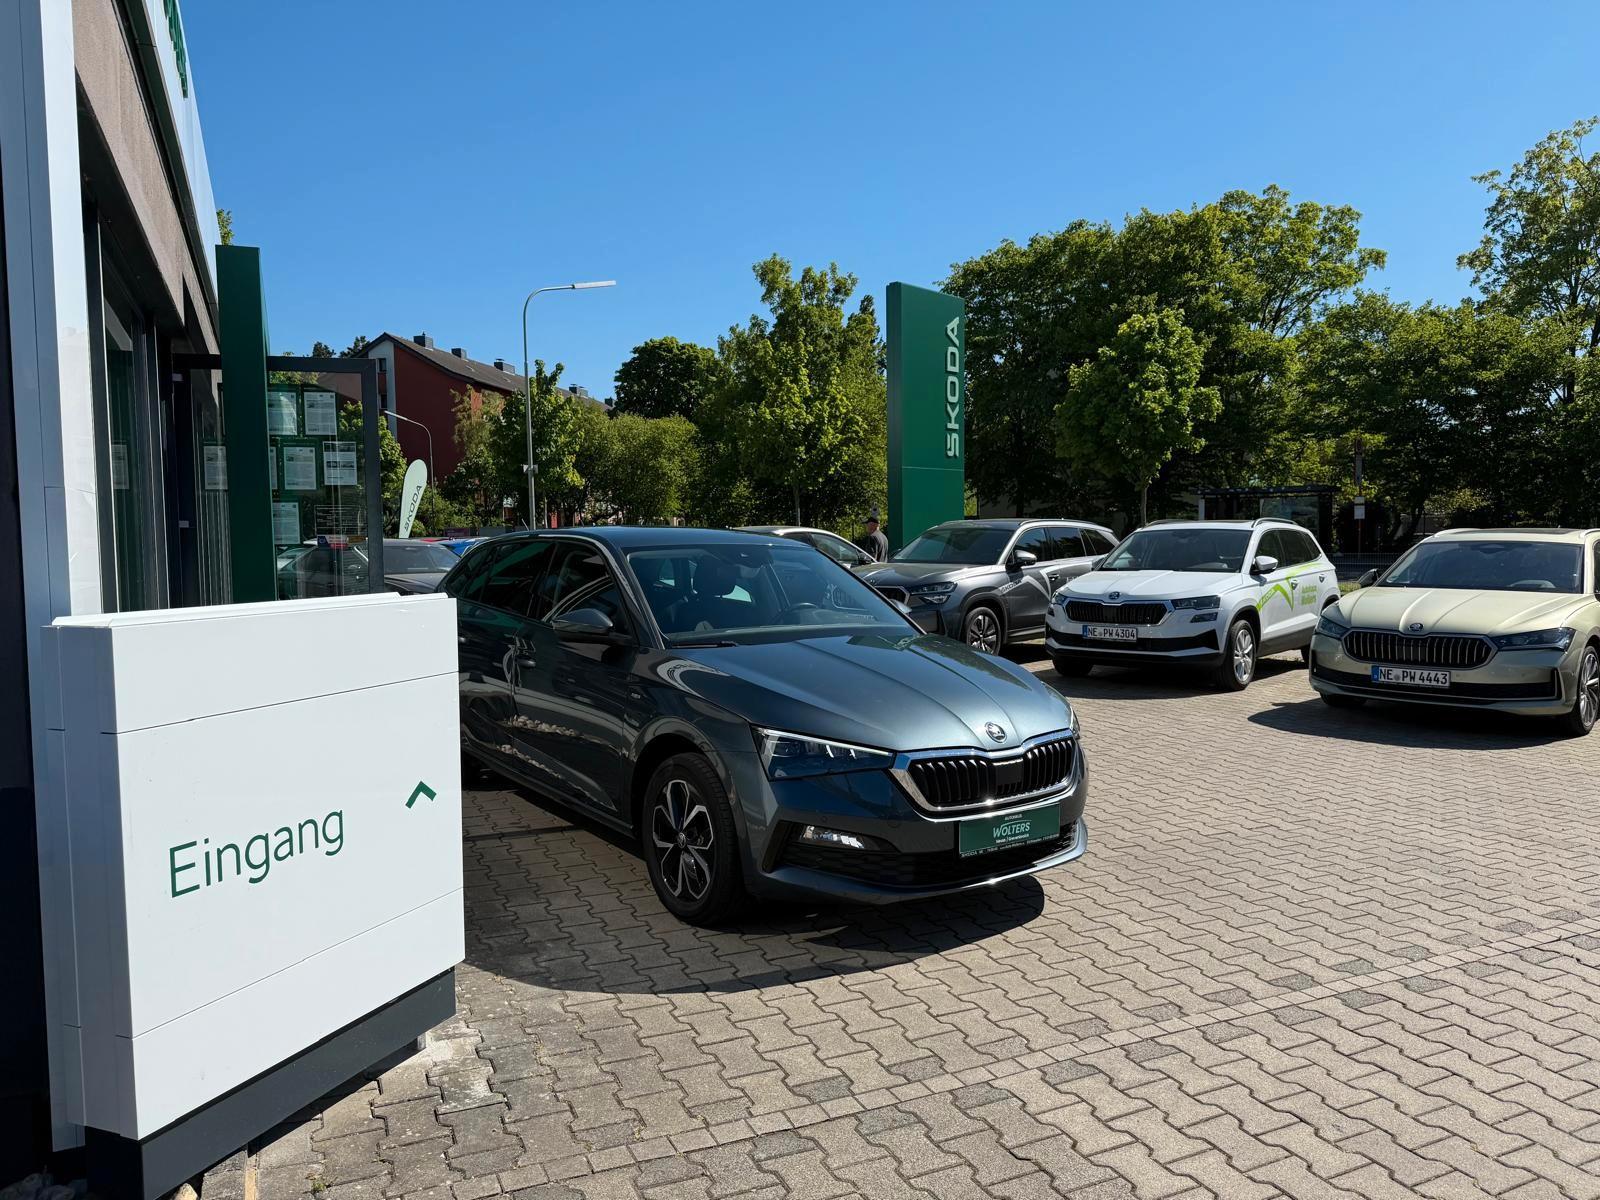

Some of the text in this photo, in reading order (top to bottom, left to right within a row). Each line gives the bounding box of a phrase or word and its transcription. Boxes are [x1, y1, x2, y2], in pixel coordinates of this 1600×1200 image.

[1088, 627, 1135, 639] NE PW 4304
[1379, 668, 1448, 685] NE PW 4443
[992, 821, 1031, 839] WOLTERS
[169, 809, 344, 898] Eingang
